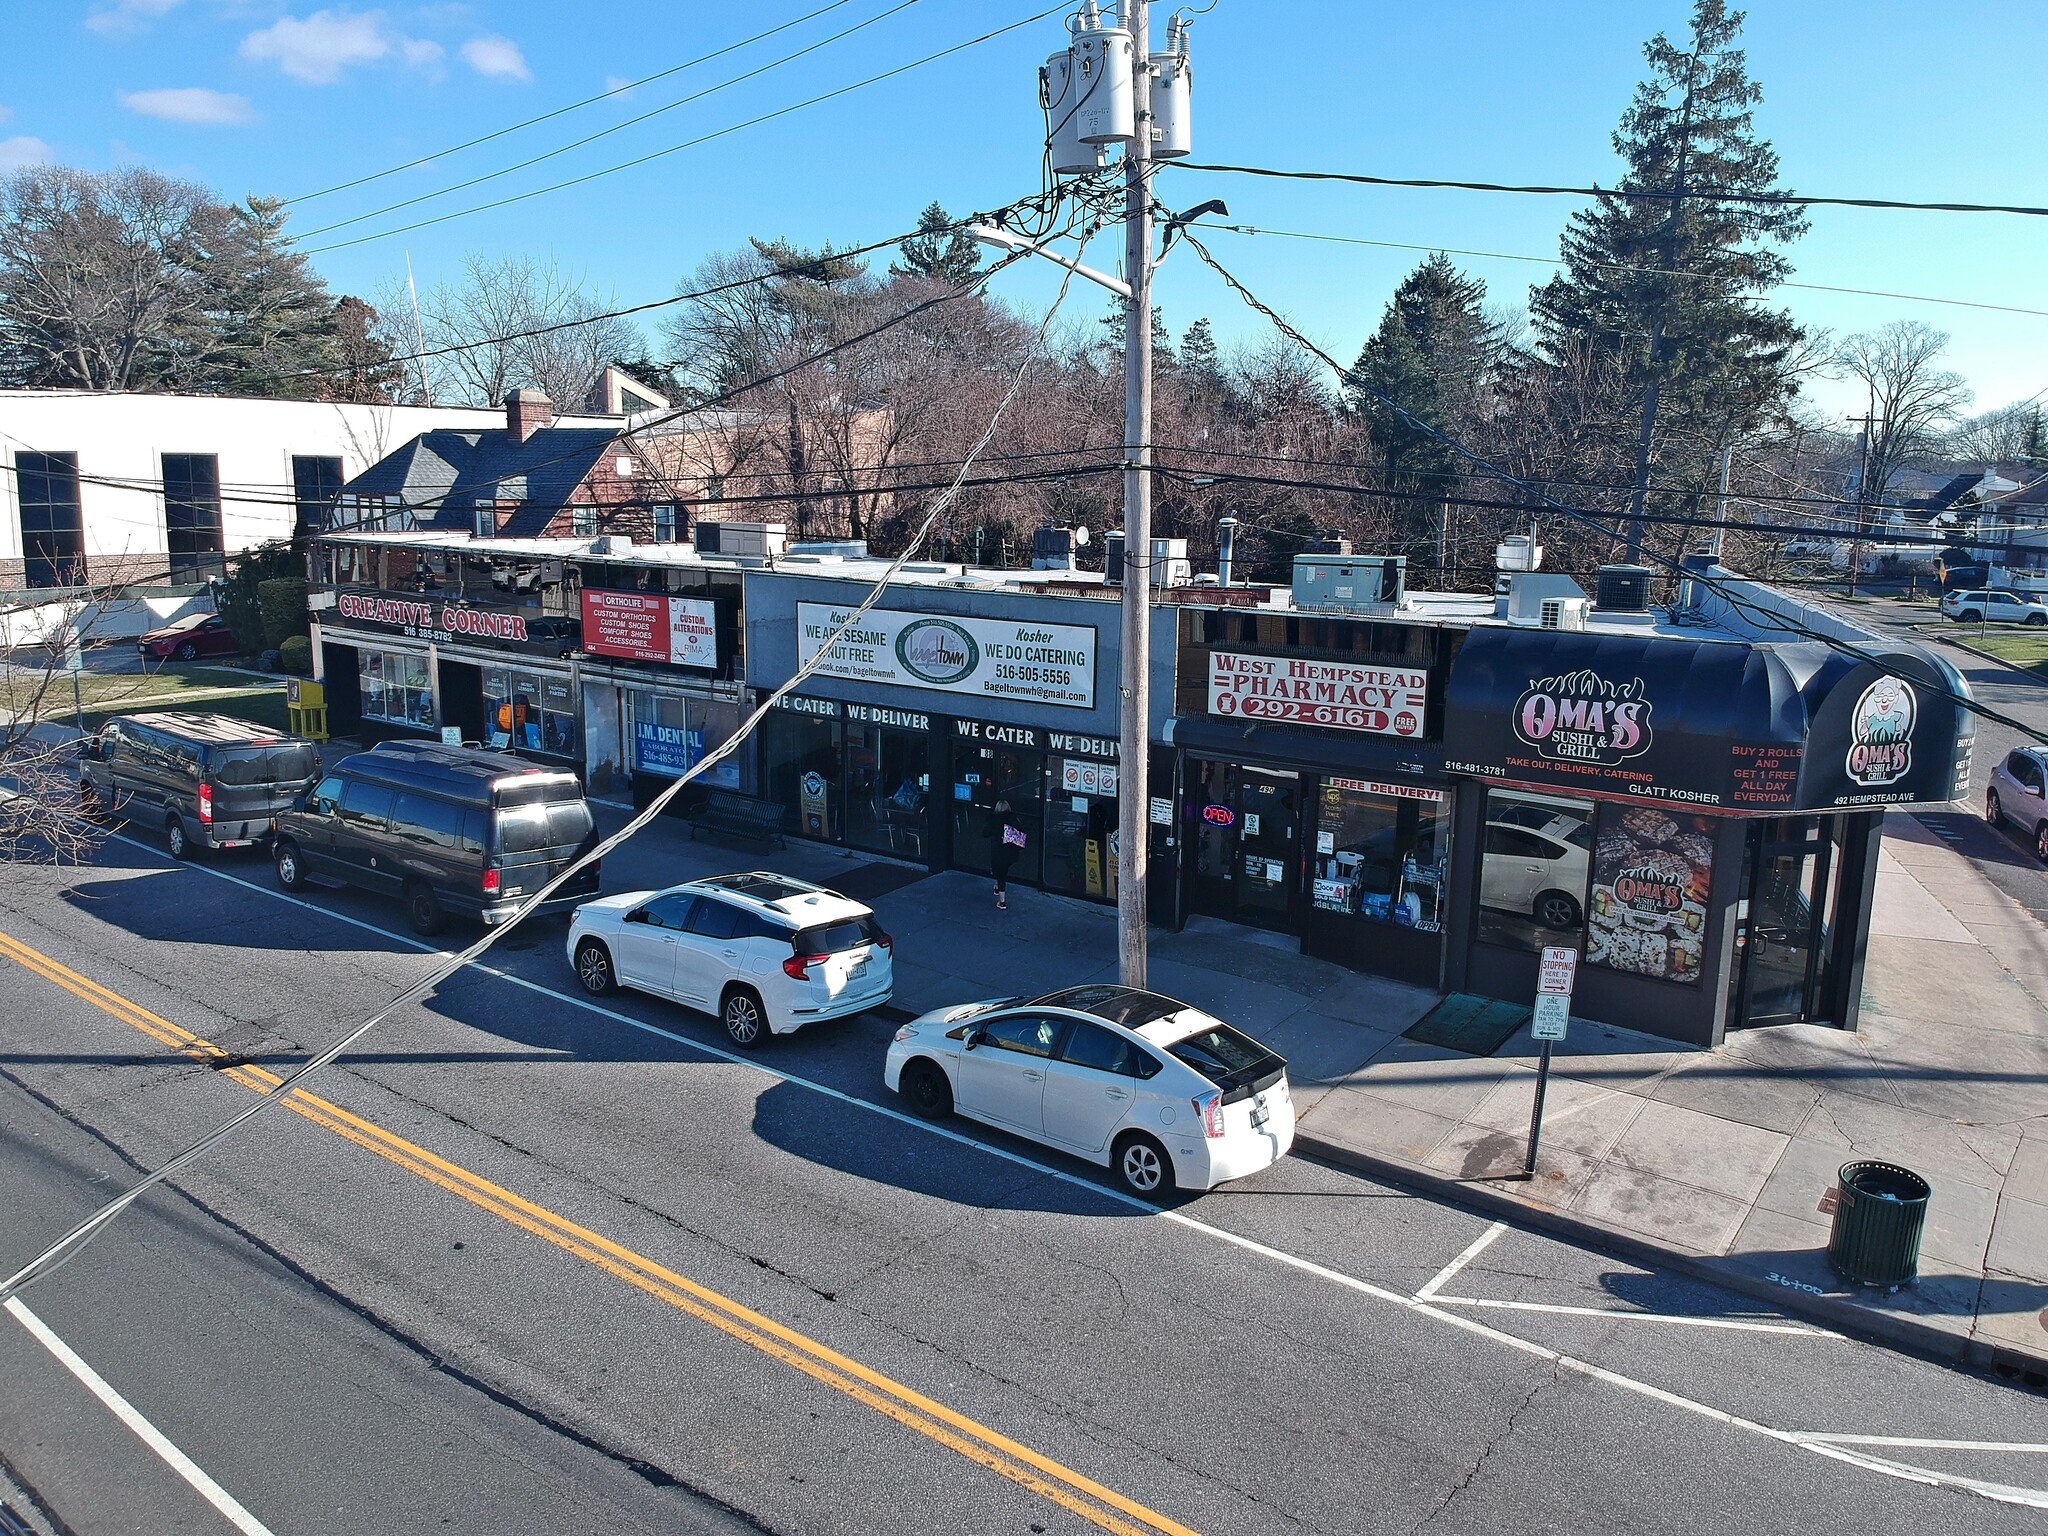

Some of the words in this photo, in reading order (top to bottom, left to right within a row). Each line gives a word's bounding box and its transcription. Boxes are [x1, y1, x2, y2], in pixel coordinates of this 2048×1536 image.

[605, 597, 642, 608] ORTHOLIFE
[339, 595, 433, 628] CREATIVE
[442, 607, 528, 642] CORNER
[593, 609, 619, 619] CUSTOM
[621, 612, 656, 623] ORTHOTICS
[600, 618, 626, 627] CUSTOM
[628, 621, 650, 630] SHOES
[680, 615, 706, 625] CUSTOM
[404, 626, 417, 637] 516
[418, 629, 453, 642] 385-8782
[598, 627, 628, 636] COMFORT
[630, 630, 652, 639] SHOES
[673, 623, 713, 635] ALTERATIONS
[806, 625, 821, 639] WE
[844, 629, 886, 646] SESAME
[1016, 628, 1053, 643] Kosher
[684, 644, 703, 654] RIMA
[827, 646, 847, 660] NUT
[849, 648, 874, 663] FREE
[985, 643, 1003, 658] WE
[1006, 645, 1022, 660] DO
[1025, 647, 1085, 666] CATERING
[996, 664, 1070, 685] 516-505-5556
[1215, 654, 1276, 675] WEST
[1288, 660, 1425, 689] HEMPSTEAD
[984, 681, 1086, 702] Bageltownwh@gmail.com
[1233, 674, 1399, 709] PHARMACY
[794, 698, 835, 715] CATER
[1249, 699, 1380, 729] 292-6161
[848, 704, 867, 720] WE
[872, 708, 929, 730] DELIVER
[1396, 716, 1415, 726] FREE
[1522, 693, 1643, 749] OMA'S
[638, 722, 656, 740] J.M.
[657, 726, 702, 748] DENTAL
[957, 720, 979, 737] WE
[985, 725, 1035, 746] CATER
[1551, 730, 1594, 747] SUSHI
[1597, 735, 1607, 748] &
[641, 741, 696, 757] LABORATOY
[1050, 733, 1073, 750] WE
[643, 750, 694, 767] 516-485-930
[1557, 745, 1600, 759] GRILL
[1732, 746, 1756, 756] BUY
[1758, 748, 1765, 757] 2
[1768, 748, 1804, 757] ROLLS
[1852, 743, 1907, 772] OMA'S
[1445, 760, 1506, 776] 516-481-3781
[1505, 757, 1529, 767] TAKE
[1531, 760, 1552, 771] OUT,
[1554, 764, 1602, 777] DELIVERY,
[1604, 769, 1653, 782] CATERING
[1755, 759, 1779, 768] AND
[1866, 763, 1885, 773] SUSHI
[1886, 764, 1891, 772] &
[1733, 769, 1757, 778] GET
[1760, 770, 1765, 779] 1
[1768, 771, 1797, 780] FREE
[1867, 772, 1887, 781] GRILL
[1260, 785, 1275, 794] 490
[1333, 778, 1365, 790] FREE
[1370, 783, 1440, 800] DELIVERY!
[1628, 784, 1667, 797] GLATT
[1669, 788, 1720, 804] KOSHER
[1741, 781, 1763, 790] ALL
[1765, 782, 1787, 791] DAY
[1327, 792, 1339, 802] ups
[1734, 791, 1792, 802] EVERYDAY
[1834, 796, 1848, 805] 492
[1849, 793, 1898, 804] HEMPSTEAD
[1898, 792, 1915, 801] AVE
[1205, 807, 1232, 823] OPEN
[1618, 878, 1679, 908] OMA'S
[1634, 896, 1655, 906] SUSHI
[1636, 904, 1659, 912] GRILL
[1418, 921, 1438, 931] OPEN
[1552, 950, 1566, 960] NO
[1542, 961, 1573, 971] STOPPING
